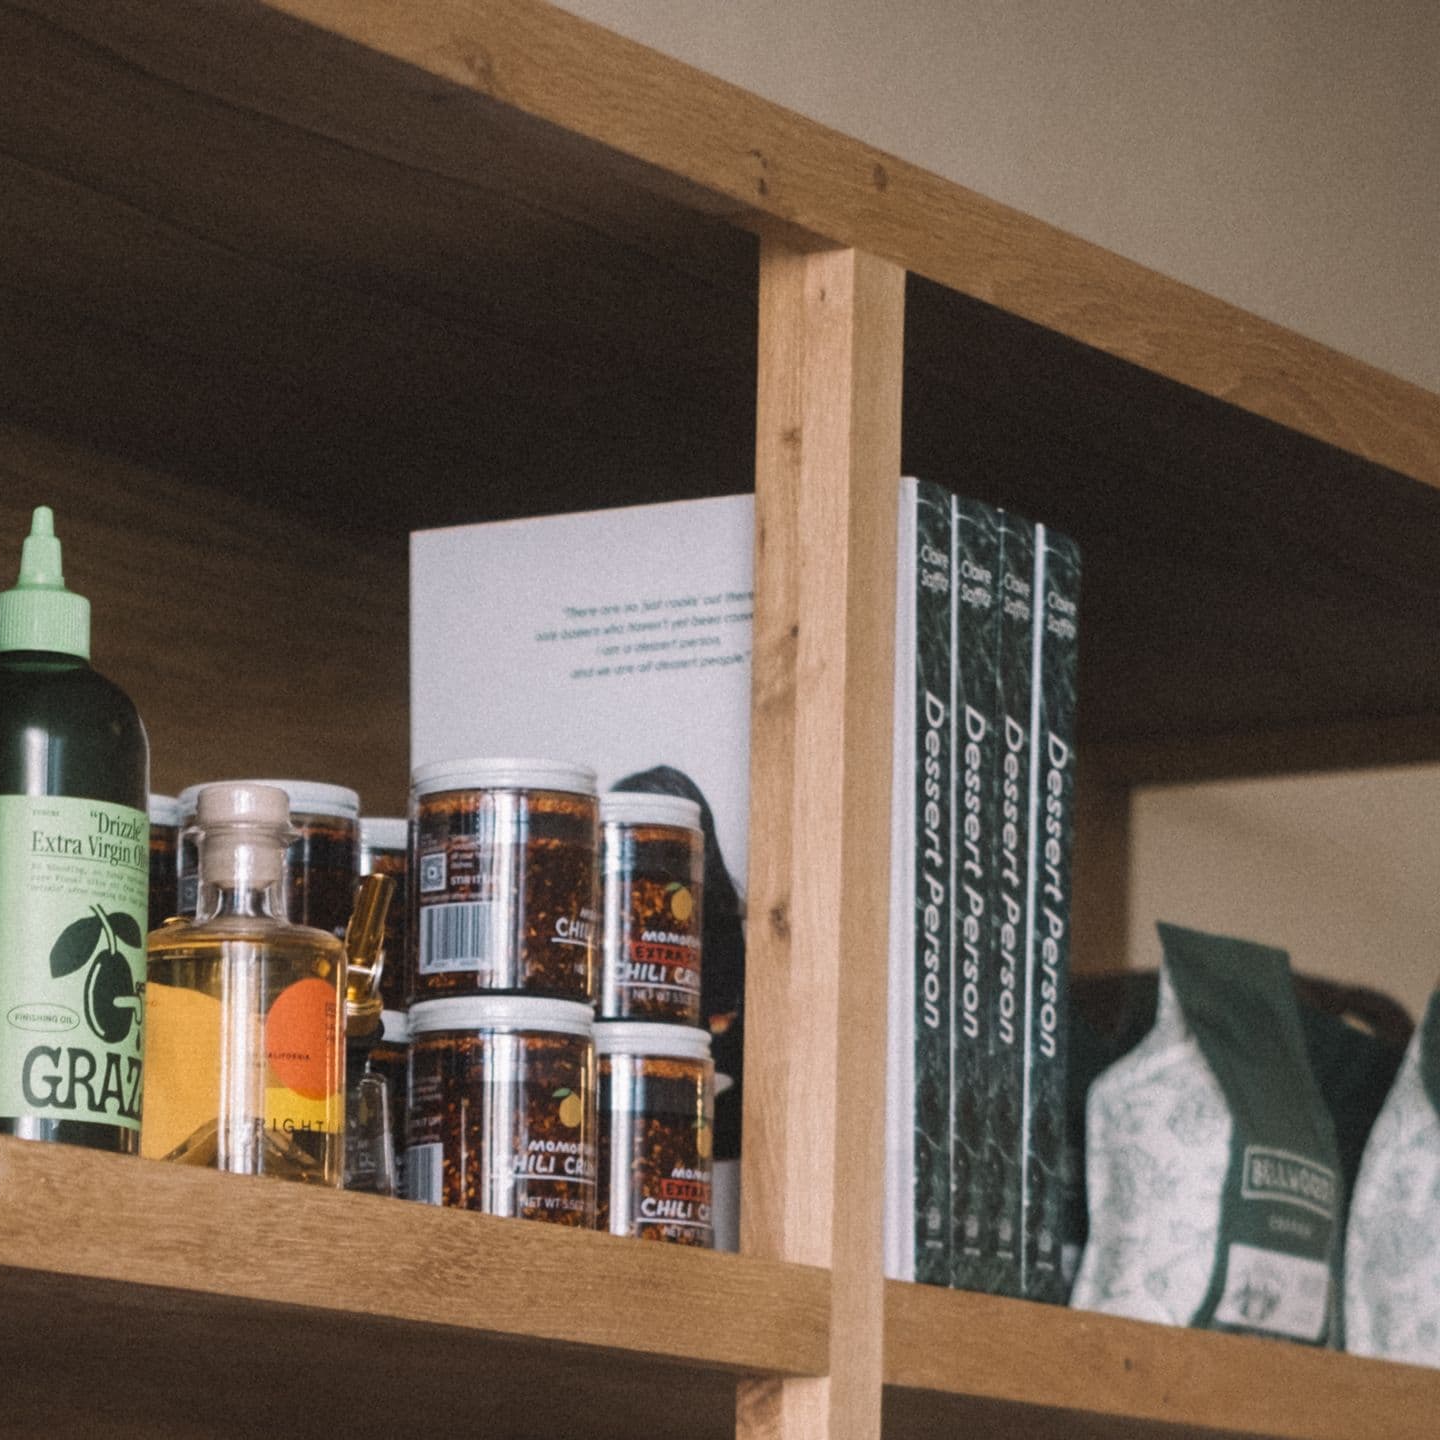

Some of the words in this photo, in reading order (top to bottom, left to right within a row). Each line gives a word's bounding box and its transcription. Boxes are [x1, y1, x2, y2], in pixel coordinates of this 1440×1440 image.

[32, 831, 82, 855] Extra
[88, 834, 131, 867] Virgin
[924, 689, 945, 869] Dessert
[964, 703, 987, 879] Dessert
[1002, 714, 1024, 889] Dessert
[1043, 730, 1069, 903] Dessert
[14, 1012, 58, 1024] FINISHING
[60, 1014, 75, 1025] OIL
[924, 870, 944, 1029] Person
[962, 881, 985, 1041] Person
[998, 890, 1021, 1045] Person
[1040, 906, 1065, 1060] Person
[510, 1154, 556, 1174] HILI
[641, 1196, 693, 1219] CHILI
